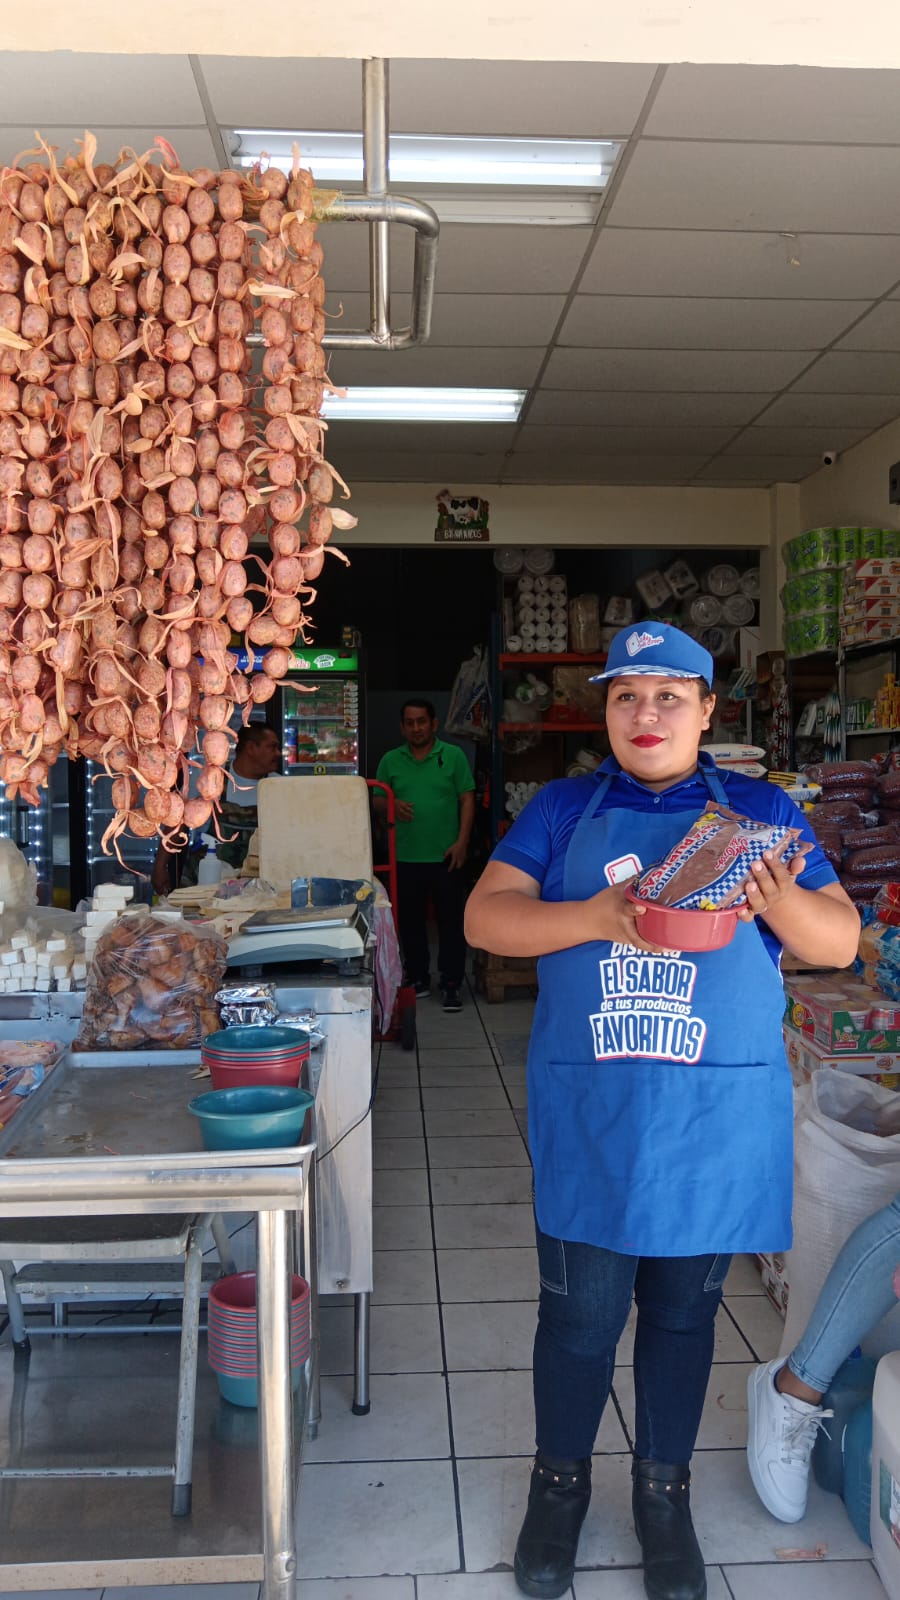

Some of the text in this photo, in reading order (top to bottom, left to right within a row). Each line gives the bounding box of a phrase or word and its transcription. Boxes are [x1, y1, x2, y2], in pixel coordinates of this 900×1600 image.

[637, 836, 695, 899] PUPUSAS
[649, 824, 723, 899] FRIJOLES FRITOS
[602, 959, 693, 999] EL SABOR
[601, 998, 692, 1015] de tus productos
[592, 1013, 703, 1060] FAVORITOS
